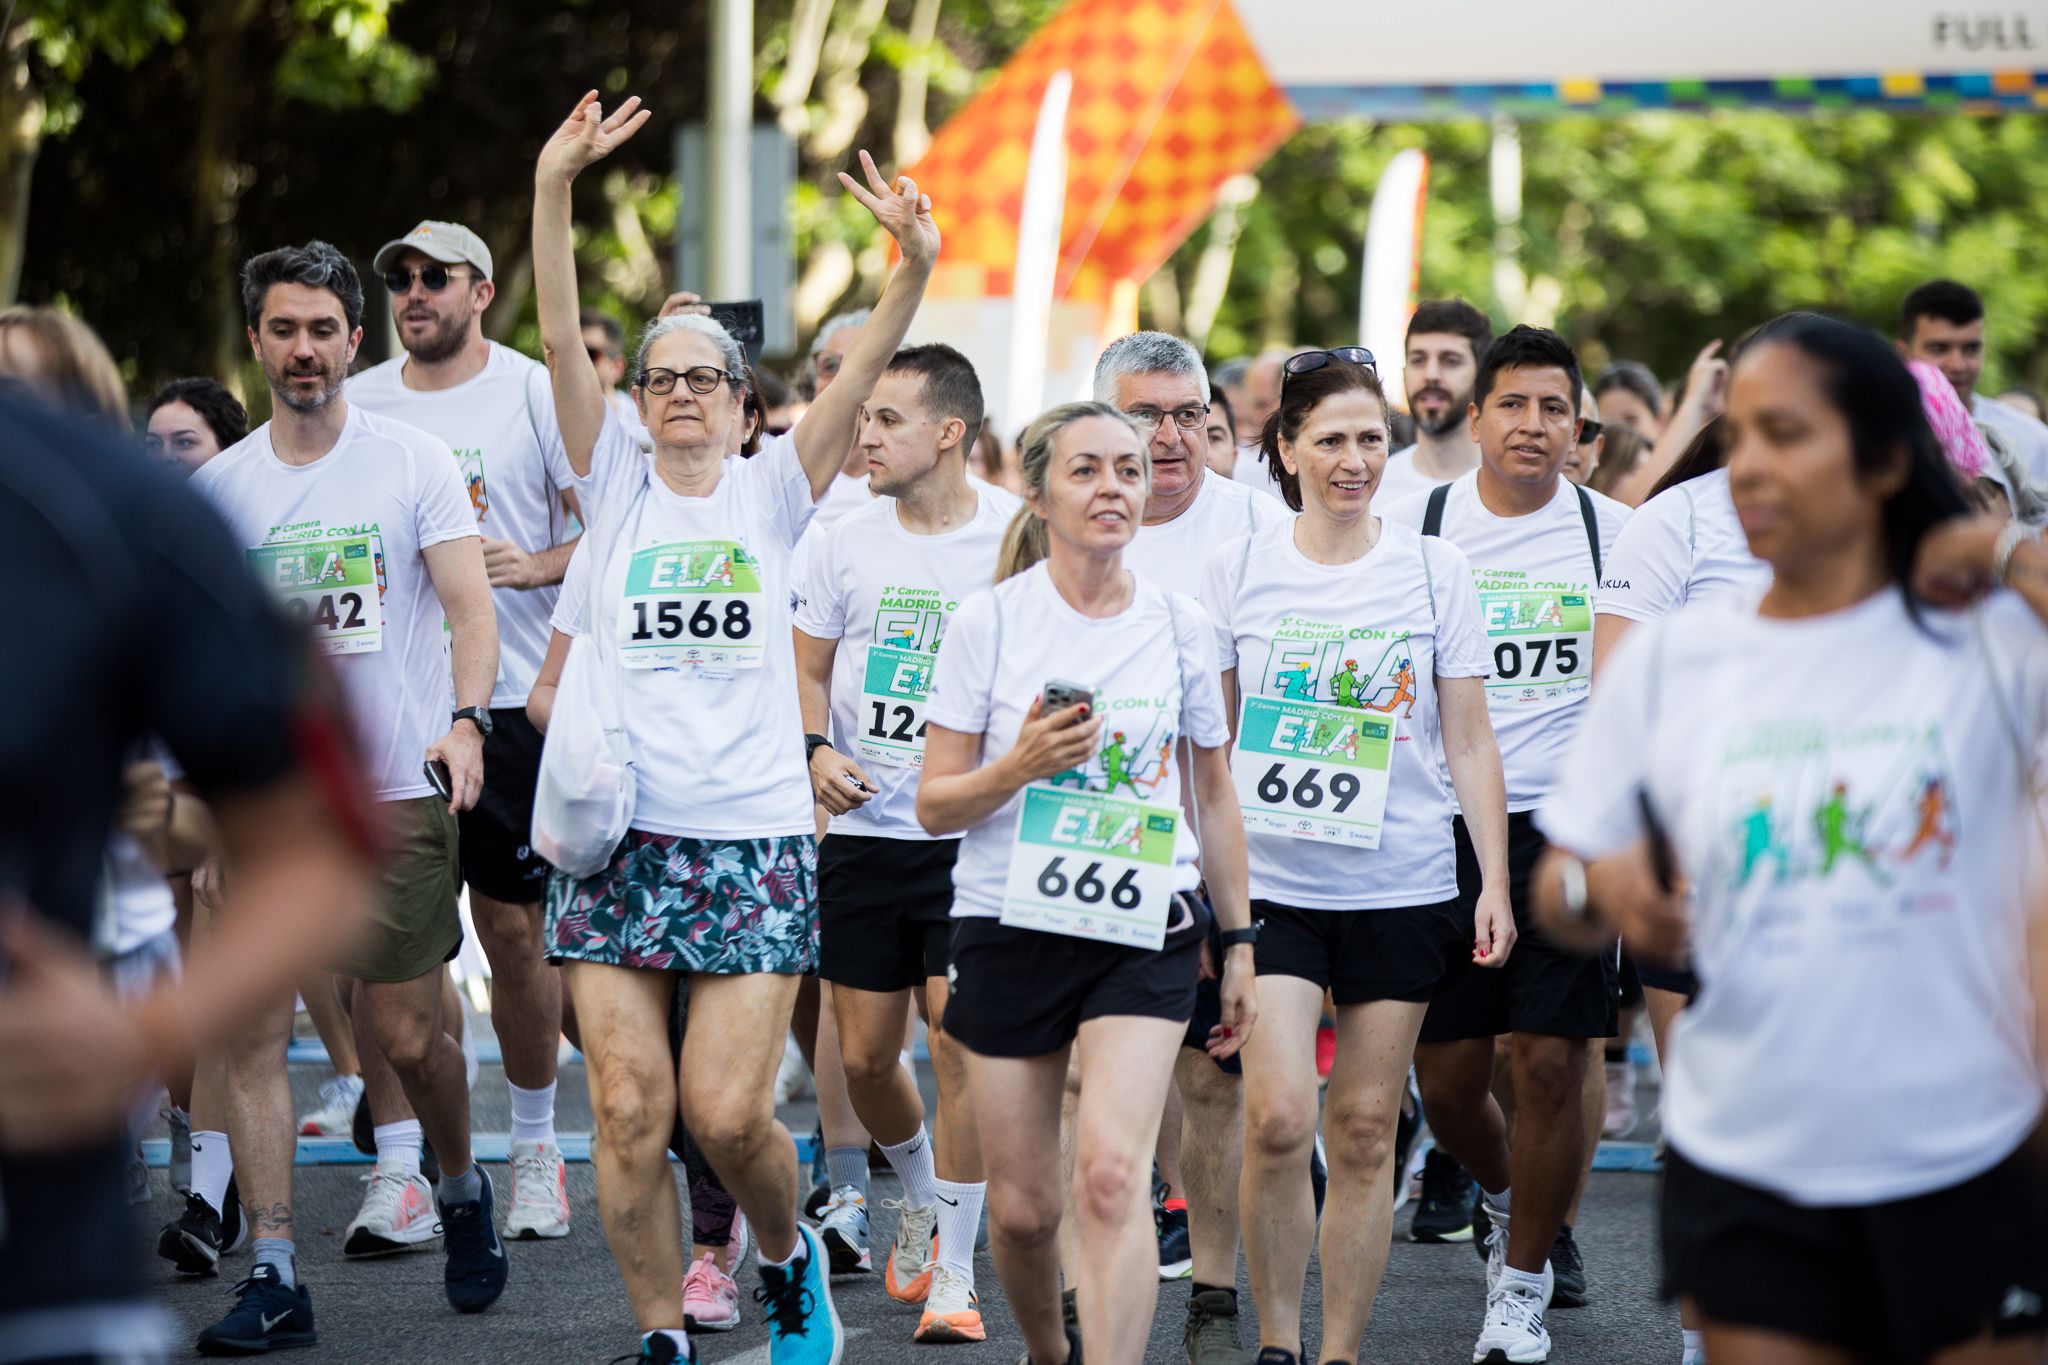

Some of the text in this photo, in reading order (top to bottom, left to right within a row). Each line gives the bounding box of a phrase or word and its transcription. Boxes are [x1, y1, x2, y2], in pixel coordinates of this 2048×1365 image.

[1933, 15, 2037, 51] FULL
[283, 520, 321, 533] Carrera
[361, 523, 381, 534] LA
[306, 545, 325, 554] CON
[326, 544, 337, 552] LA
[274, 552, 346, 588] ELA
[648, 553, 734, 588] ELA
[1484, 569, 1526, 578] Carrera
[897, 587, 940, 597] Carrera
[1534, 581, 1567, 590] CON
[880, 598, 941, 610] MADRID
[632, 599, 752, 640] 1568
[1485, 599, 1563, 631] ELA
[1295, 619, 1343, 631] Carrera
[1275, 628, 1412, 640] MADRID CON LA
[900, 655, 932, 665] MADRID
[1483, 638, 1579, 679] 075
[1112, 697, 1149, 710] CON
[1258, 702, 1280, 711] Carrera
[1282, 705, 1320, 718] MADRID
[1321, 712, 1342, 721] CON
[1343, 715, 1355, 723] LA
[1270, 714, 1358, 760] ELA
[1257, 762, 1361, 813] 669
[1051, 805, 1142, 854] ELA
[1037, 856, 1142, 910] 666
